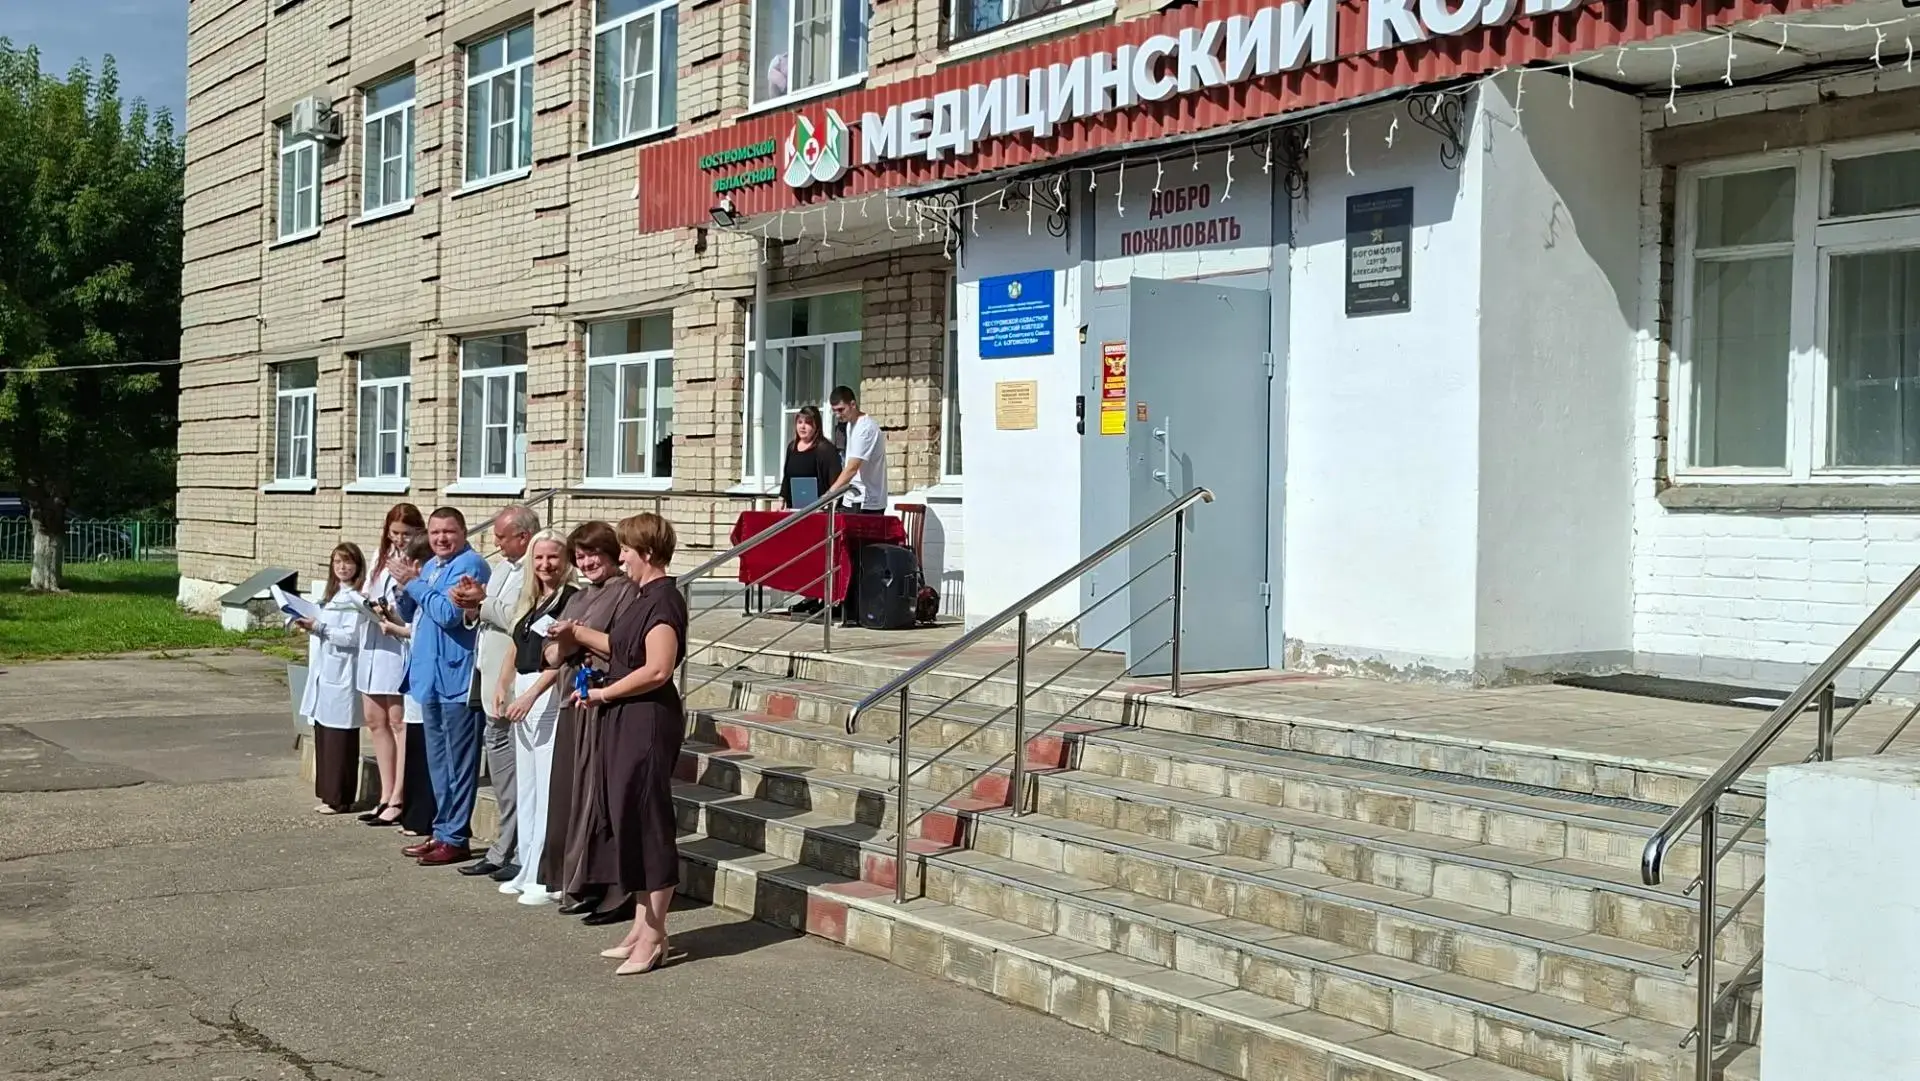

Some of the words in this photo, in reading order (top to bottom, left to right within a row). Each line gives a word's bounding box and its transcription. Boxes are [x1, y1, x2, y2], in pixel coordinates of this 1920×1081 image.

[861, 0, 1336, 164] МЕДИЦИНСКИЙ
[699, 136, 776, 168] КОСТРОМСКОЙ
[713, 163, 776, 192] ОБЛАСТНОЙ
[1149, 183, 1211, 221] ДОБРО
[1121, 216, 1242, 256] ПОЖАЛОВАТЬ
[1353, 246, 1402, 258] БОГОМОЛОВ
